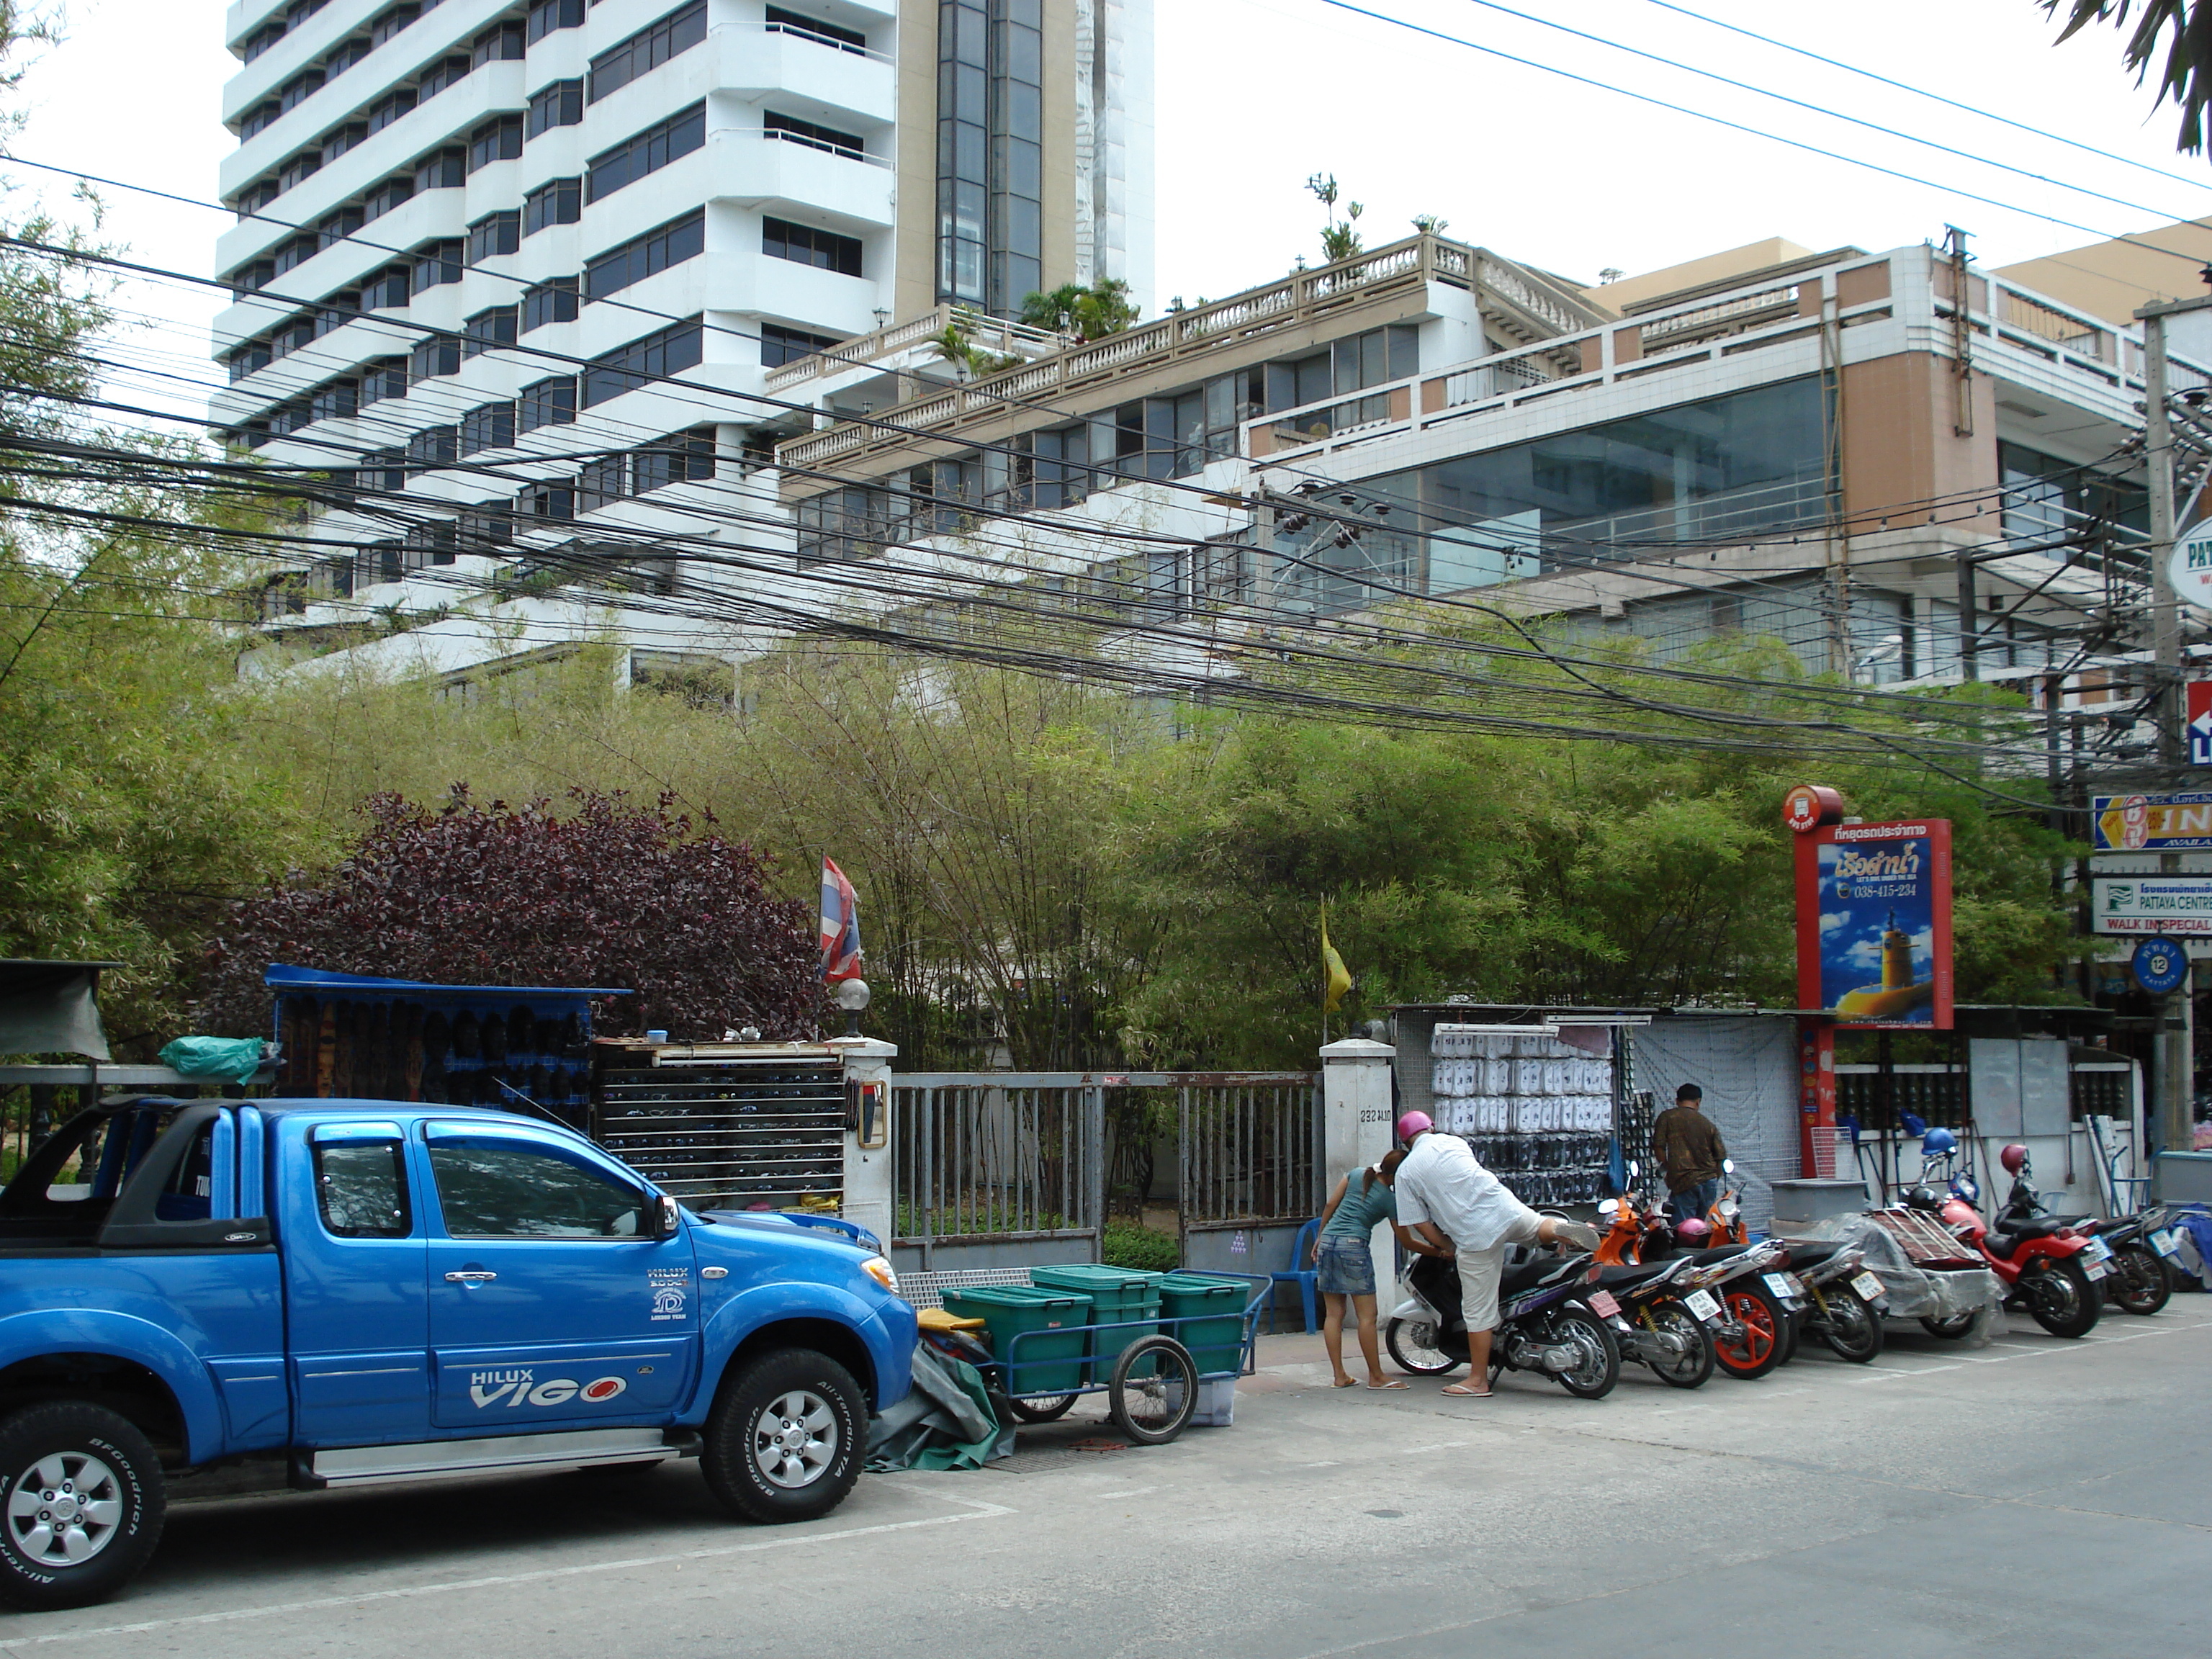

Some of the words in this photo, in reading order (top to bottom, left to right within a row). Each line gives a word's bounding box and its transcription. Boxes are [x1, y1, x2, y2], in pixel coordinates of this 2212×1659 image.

[1789, 817, 1800, 830] BUS
[1801, 817, 1815, 830] STOP
[1835, 824, 1927, 842] ที่หยุดรถประจำทาง
[1835, 842, 1920, 877] เรือดำน้ำ
[1854, 884, 1916, 898] 038-415-234
[2140, 896, 2176, 909] PATTAYA
[2108, 919, 2141, 930] WALK
[2144, 919, 2159, 930] IN
[2161, 920, 2211, 930] SPECIAL
[2154, 959, 2165, 970] 12
[2144, 974, 2176, 986] PATTAYA
[1360, 1110, 1376, 1123] 232
[647, 1267, 688, 1278] HILUX
[472, 1369, 534, 1385] HILUX
[469, 1376, 627, 1408] VIGO
[817, 1380, 854, 1452] All-Terrain
[743, 1406, 775, 1497] BFGoodrich
[89, 1438, 143, 1536] BFGoodrich
